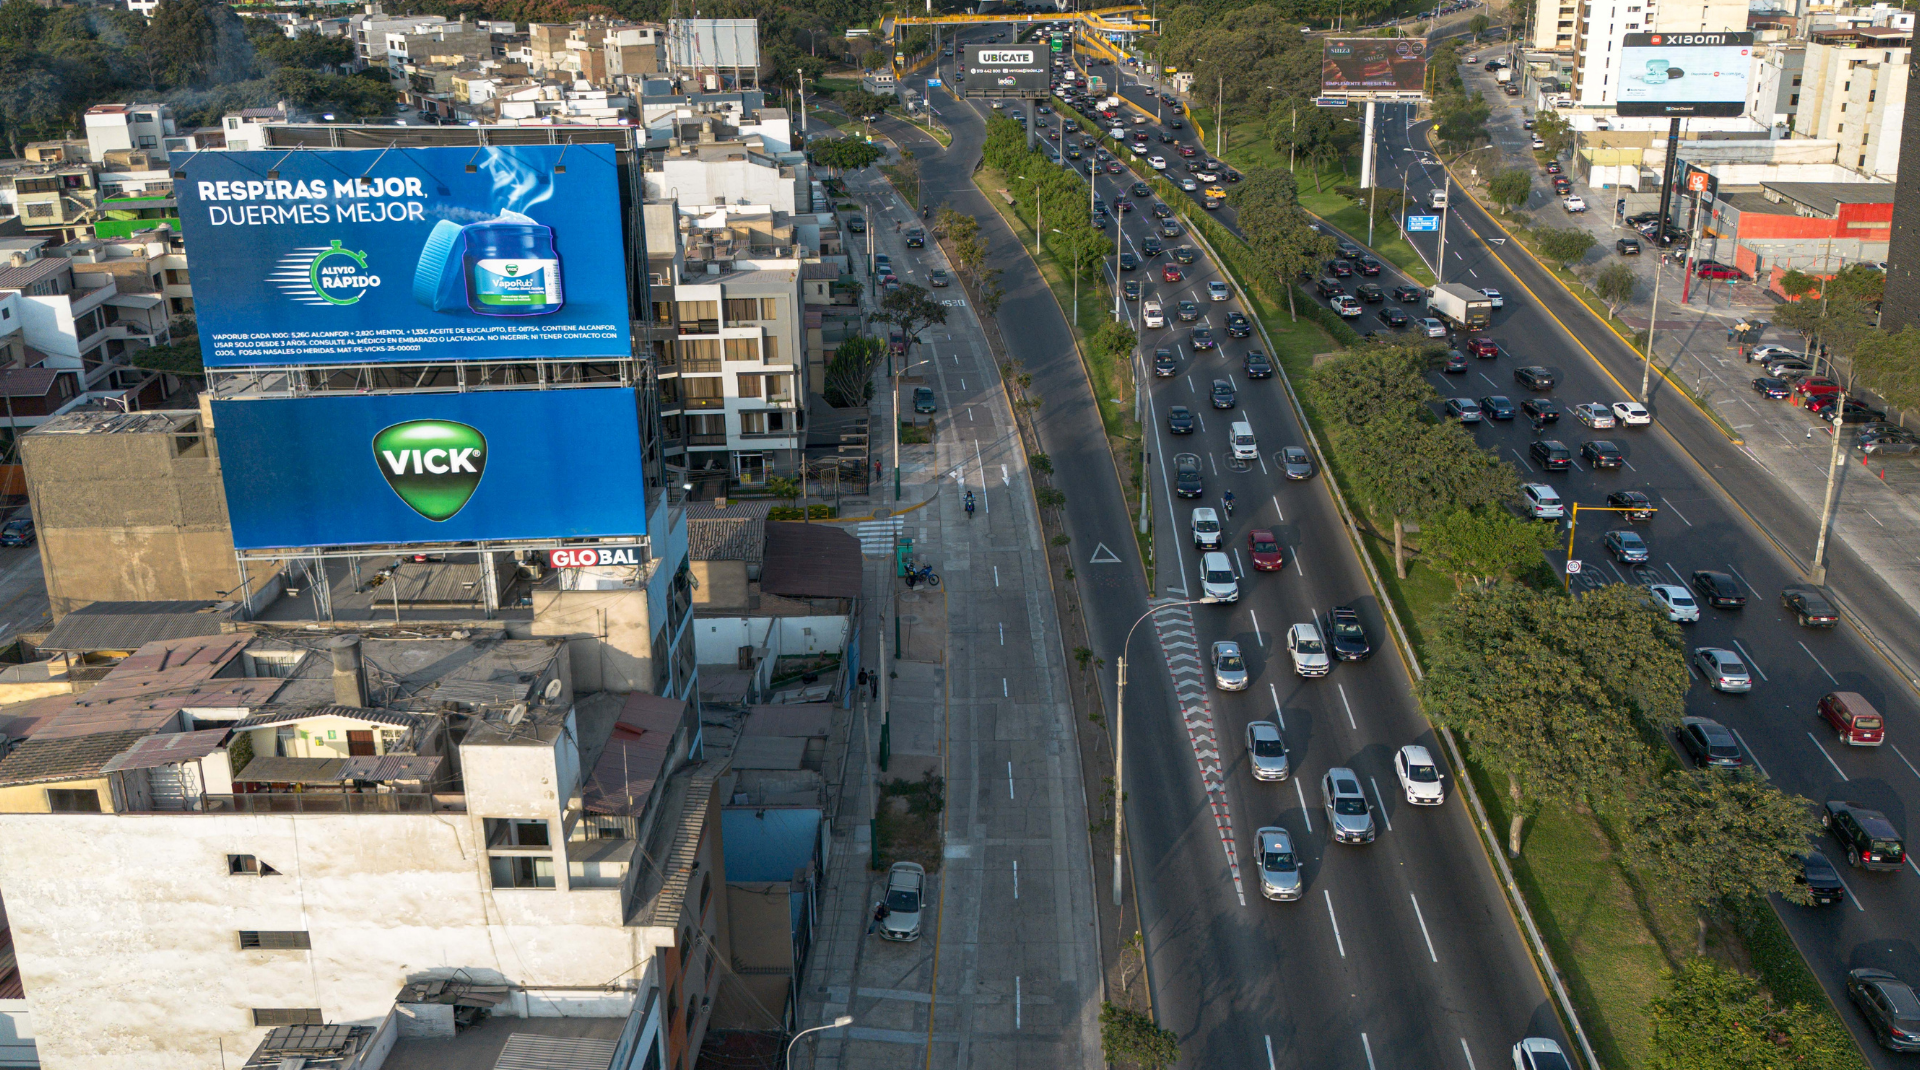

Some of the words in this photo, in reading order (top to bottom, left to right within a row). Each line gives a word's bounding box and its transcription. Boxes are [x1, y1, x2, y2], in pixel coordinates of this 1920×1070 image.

[983, 52, 1030, 62] UBÍCATE
[198, 180, 328, 201] RESPIRAS
[333, 177, 428, 198] MEJOR,
[209, 204, 330, 226] DUERMES
[336, 202, 425, 223] MEJOR
[321, 266, 356, 275] ALIVIO
[322, 274, 381, 289] RÁPIDO
[250, 332, 271, 340] CADA
[311, 330, 349, 338] ALCANFOR
[376, 329, 405, 337] MENTOL
[467, 327, 507, 335] EUCALIPTO,
[541, 325, 577, 333] CONTIENE
[578, 324, 617, 332] ALCANFOR,
[214, 341, 233, 349] USAR
[255, 340, 280, 348] DESDE
[387, 337, 397, 345] EN
[398, 336, 438, 344] EMBARAZO
[602, 332, 618, 340] CON
[238, 348, 262, 356] FOSAS
[263, 347, 295, 355] NASALES
[552, 549, 639, 567] GLOBAL
